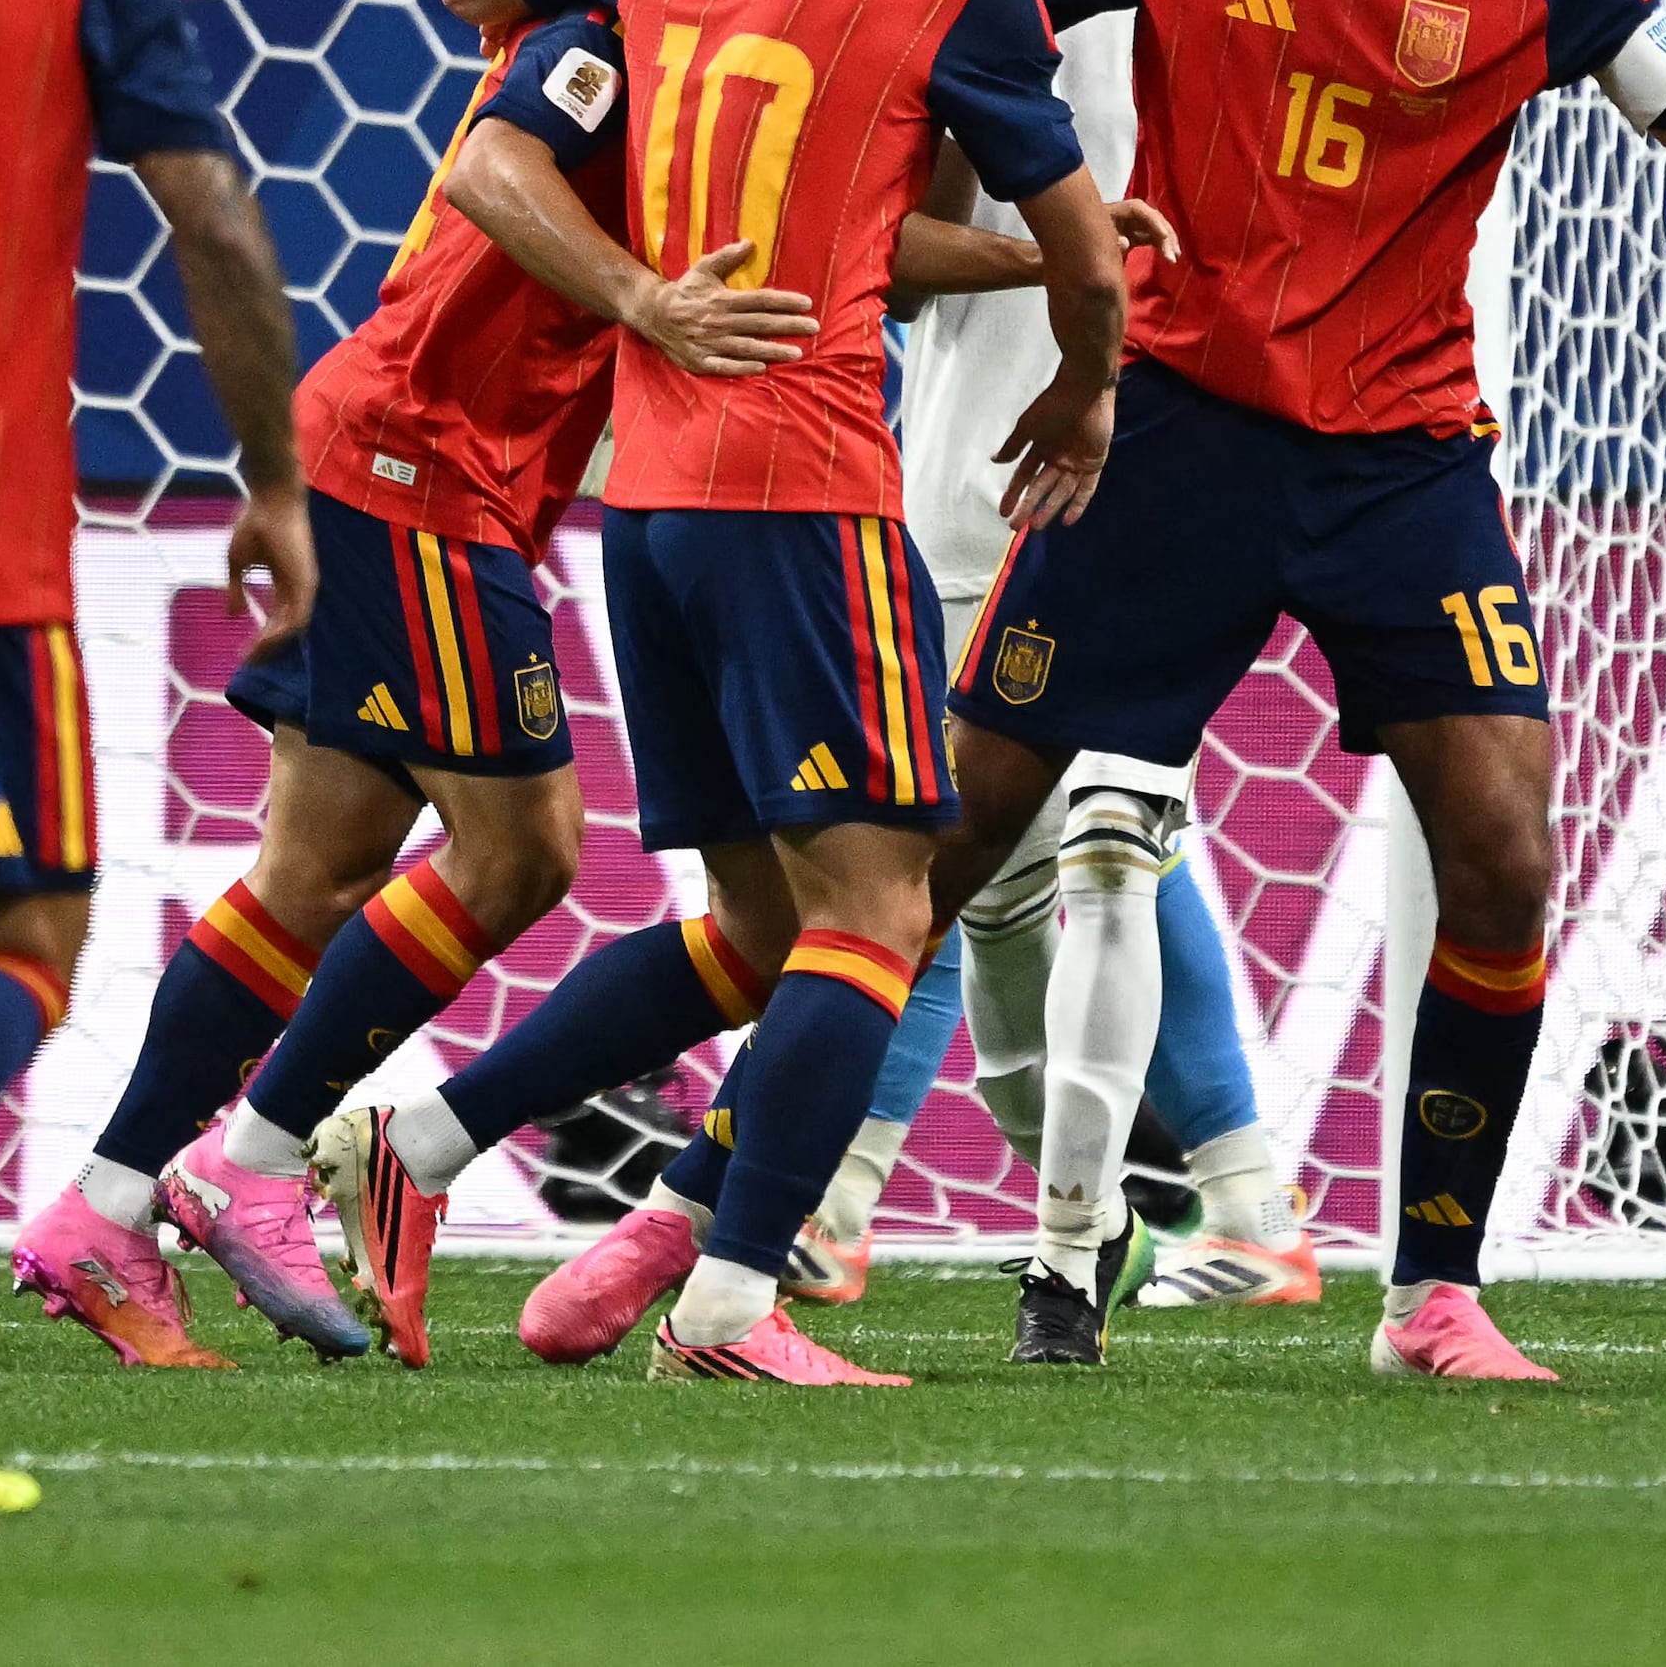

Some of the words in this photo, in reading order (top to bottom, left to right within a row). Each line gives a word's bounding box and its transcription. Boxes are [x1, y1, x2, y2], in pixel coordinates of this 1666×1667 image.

[643, 24, 815, 291] 10
[1277, 73, 1373, 188] 16
[1441, 587, 1539, 687] 16
